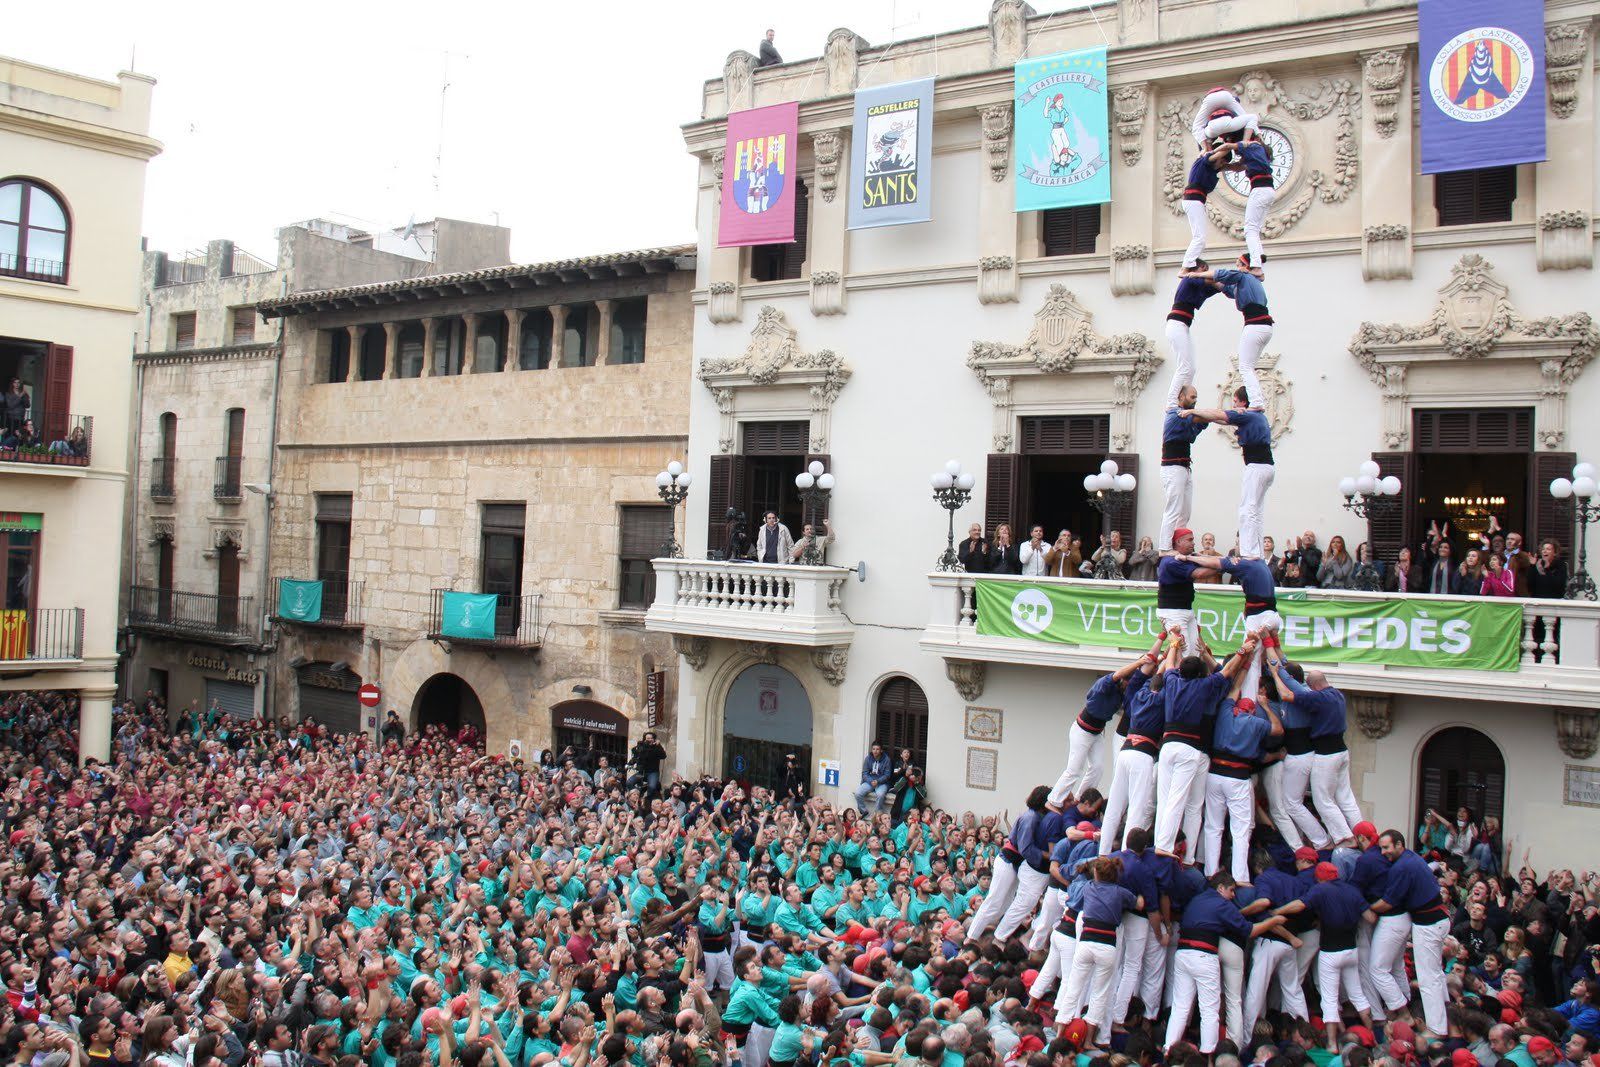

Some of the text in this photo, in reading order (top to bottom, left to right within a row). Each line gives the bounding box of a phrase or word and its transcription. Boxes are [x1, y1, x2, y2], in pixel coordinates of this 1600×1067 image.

[1436, 29, 1530, 65] COLLA CASTELLERA
[1035, 74, 1087, 91] CASTELLERS
[868, 99, 919, 116] CASTELLERS
[1433, 88, 1482, 120] CAPGROSSOS
[1484, 108, 1497, 118] DE
[1277, 142, 1283, 153] 2
[1280, 155, 1286, 166] 3
[1035, 170, 1092, 185] VILAFRANCA
[1234, 172, 1239, 182] 8
[1276, 168, 1281, 178] 4
[863, 172, 916, 207] SANTS
[1244, 180, 1250, 191] 7
[1077, 602, 1472, 654] VEGURIA ENEDÈS
[648, 675, 656, 727] marsan
[563, 717, 582, 726] nutrició
[586, 719, 598, 728] salut
